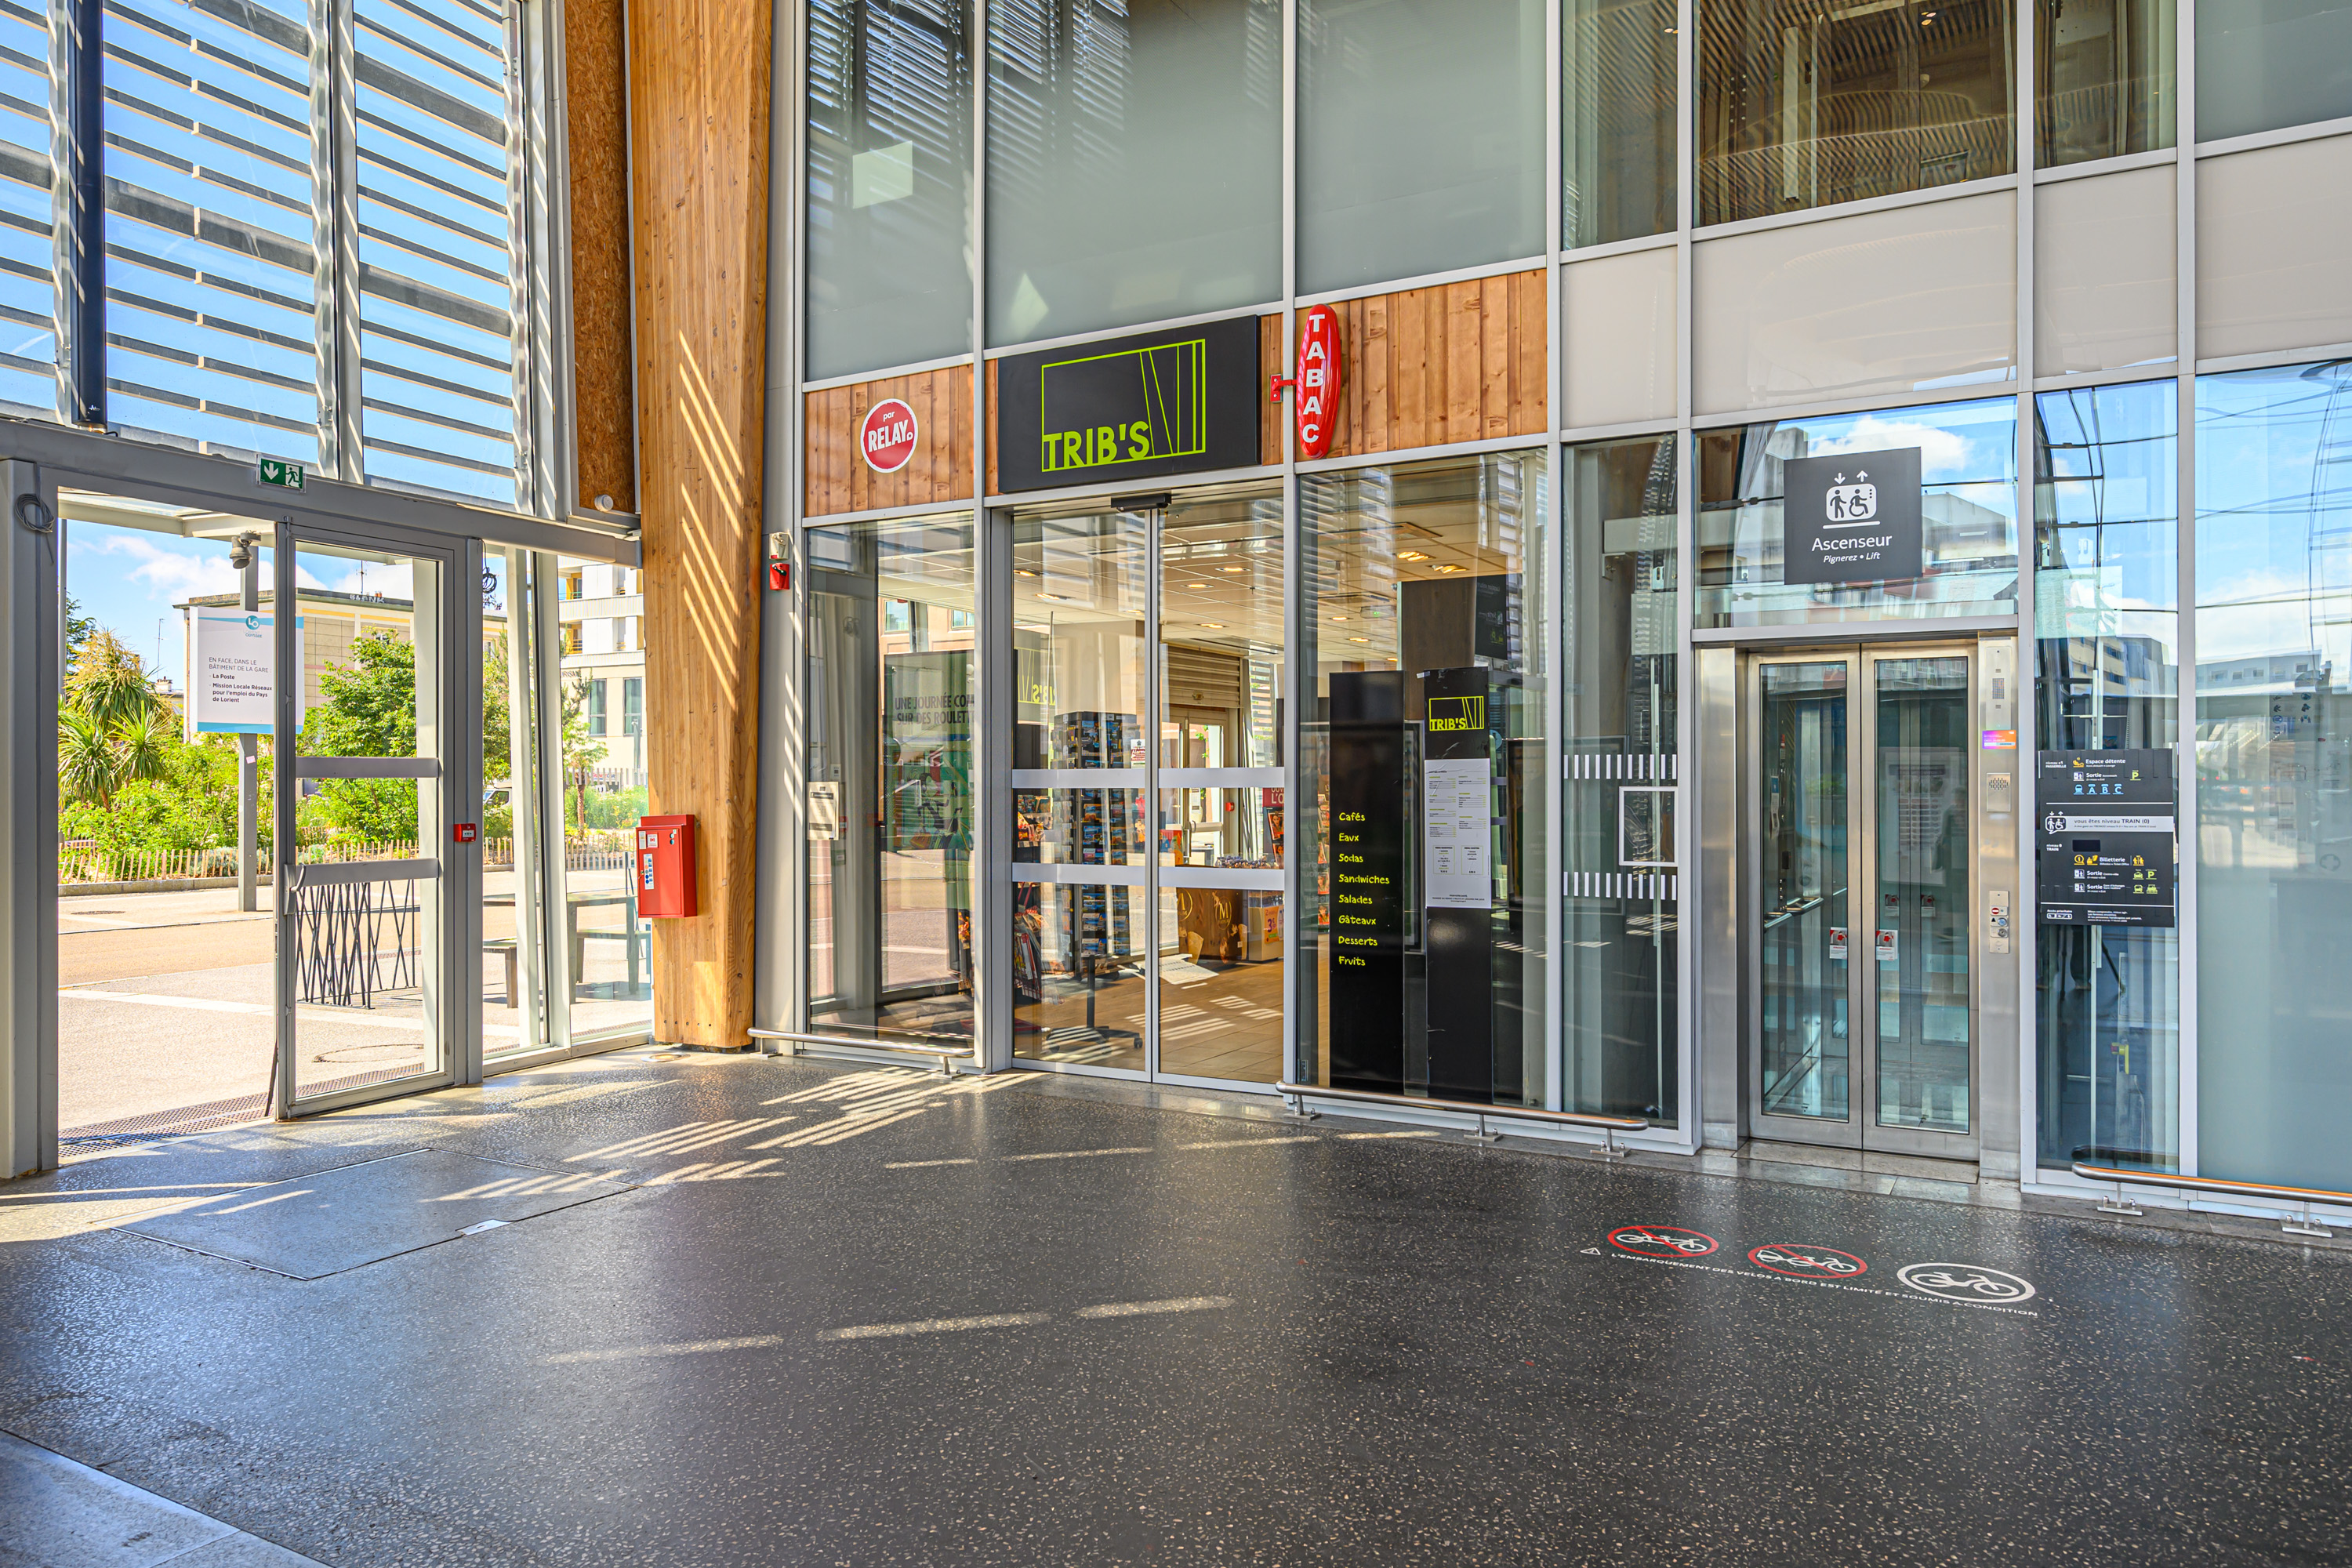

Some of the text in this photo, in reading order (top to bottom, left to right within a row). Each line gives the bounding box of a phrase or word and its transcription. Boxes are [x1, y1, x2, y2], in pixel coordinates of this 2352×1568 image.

[1302, 314, 1326, 444] TABAC
[883, 412, 895, 423] par
[868, 419, 909, 453] RELAY
[1044, 420, 1150, 470] TRIB'S
[1811, 535, 1893, 552] Ascenseur
[1823, 551, 1881, 564] Pignerez Lift
[895, 696, 912, 710] UNE
[913, 692, 952, 710] JOURNÉE
[897, 712, 913, 725] SUR
[916, 711, 931, 725] DES
[1430, 717, 1466, 730] TRIB'S
[1338, 811, 1366, 821] Cafés
[1338, 833, 1359, 842] Eaux
[1338, 853, 1364, 862] Sodas
[1338, 873, 1390, 884] Sandwiches
[1338, 894, 1373, 904] Salades
[1338, 914, 1377, 925] Gâteaux
[1338, 935, 1378, 946] Desserts
[1338, 955, 1366, 966] Fruits
[1611, 1253, 1711, 1270] L'EMBARQUEMENT
[1784, 1277, 1817, 1286] BORD
[1901, 1294, 1950, 1304] SOUMIS
[1964, 1303, 2038, 1316] CONDITION
